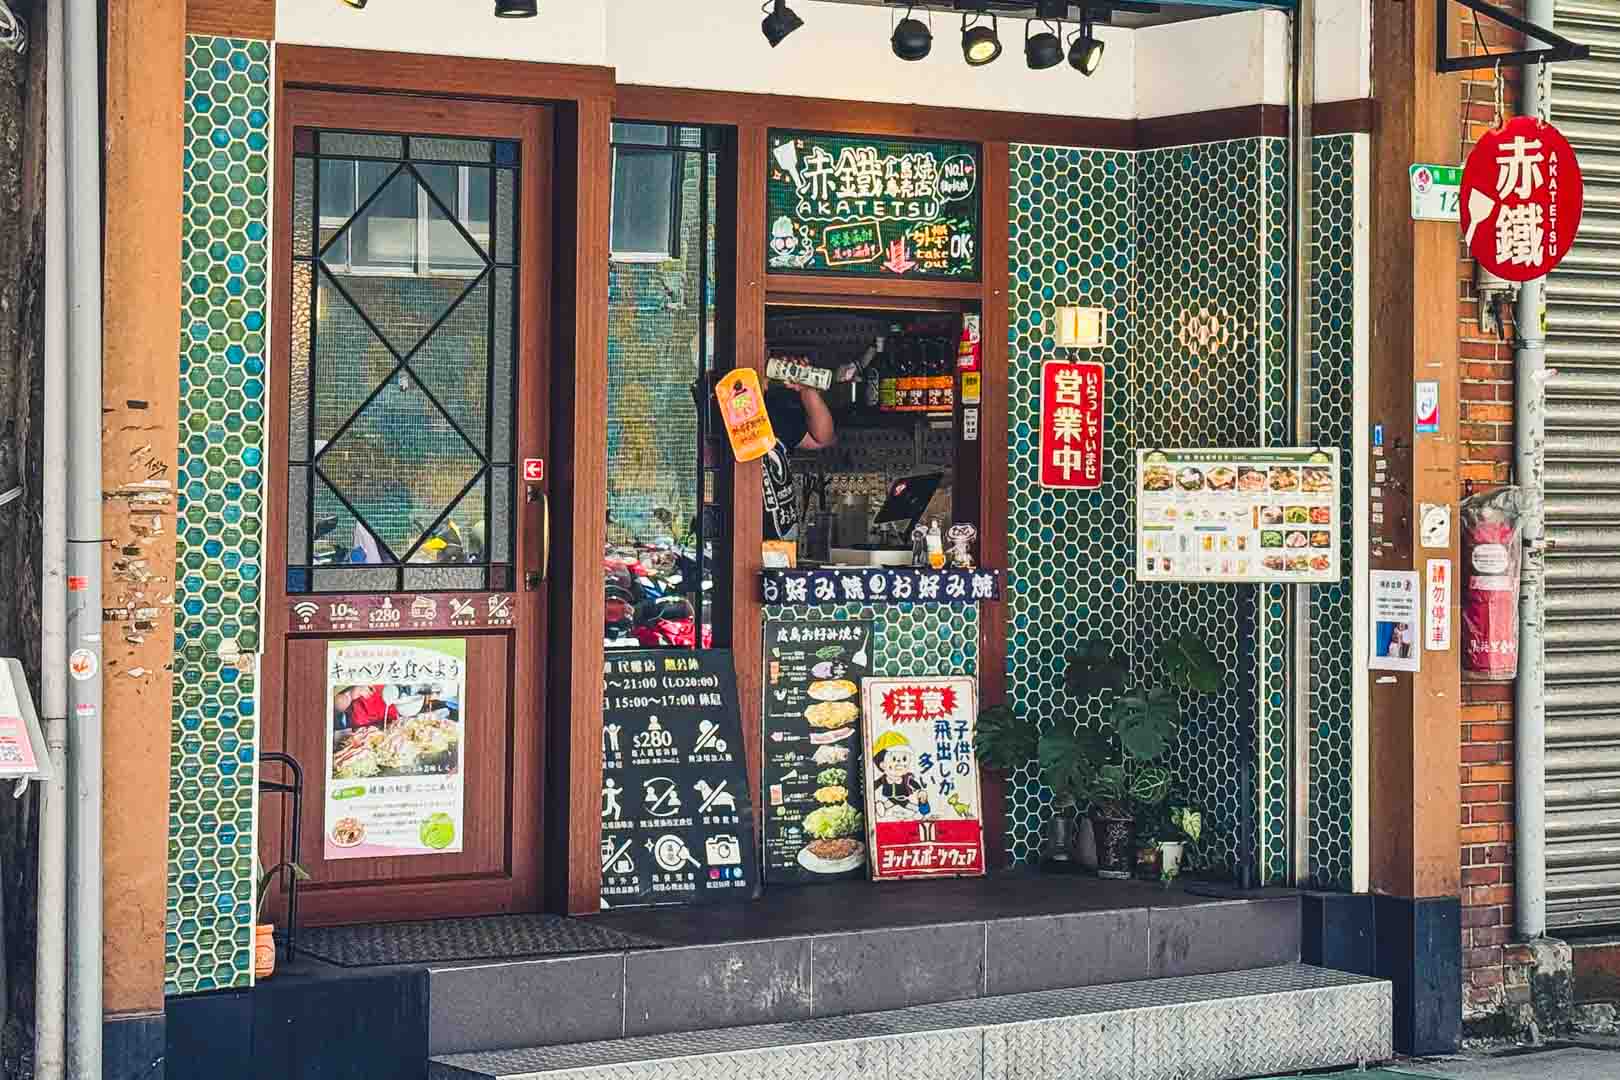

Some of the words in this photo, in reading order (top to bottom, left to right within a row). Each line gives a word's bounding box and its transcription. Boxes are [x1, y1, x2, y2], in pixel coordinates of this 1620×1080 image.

[800, 200, 937, 218] AKATETSU
[1496, 135, 1545, 267] 赤鐵
[1548, 151, 1559, 258] AKATETSU
[1053, 368, 1082, 481] 営業中
[1085, 371, 1098, 480] いらっしゃいませ
[763, 574, 867, 602] お好み焼
[892, 573, 994, 599] お好み焼
[329, 603, 360, 618] 10%
[368, 608, 401, 623] $280
[1430, 564, 1446, 643] 請勿停車
[777, 628, 862, 643] 広島お好み焼き
[331, 658, 460, 681] キャベツを食べよう
[893, 691, 945, 716] 注意
[632, 731, 673, 749] $280
[953, 719, 973, 778] 子供の
[918, 752, 937, 790] 多い
[934, 719, 955, 798] 飛出しが
[881, 847, 979, 870] ヨットスポーツウェア
